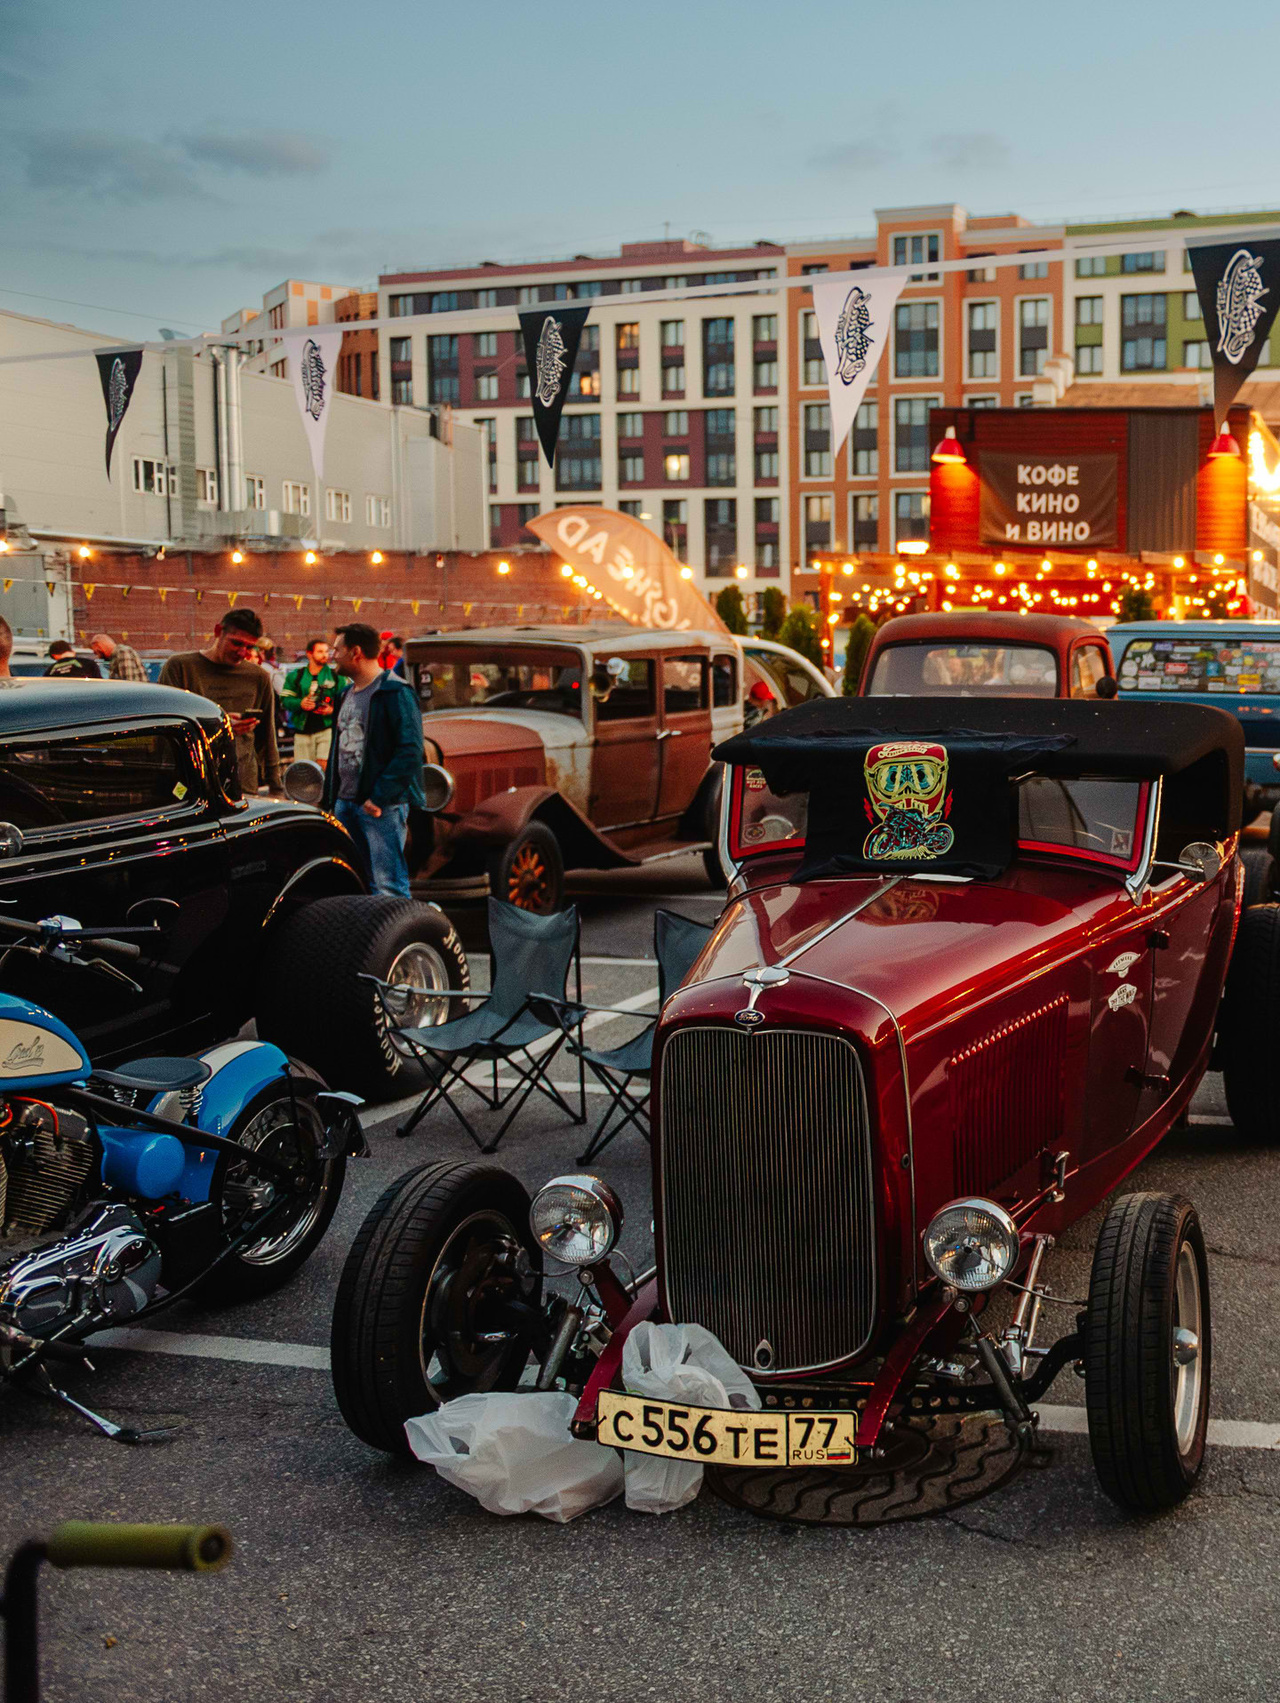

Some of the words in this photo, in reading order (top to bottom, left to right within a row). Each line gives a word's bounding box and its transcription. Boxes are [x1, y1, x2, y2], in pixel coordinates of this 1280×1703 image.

[1017, 464, 1079, 487] КОФЕ
[1017, 492, 1080, 515] КИНО
[1027, 520, 1091, 542] ВИНО
[795, 1418, 837, 1448] 77
[792, 1449, 825, 1460] RUS
